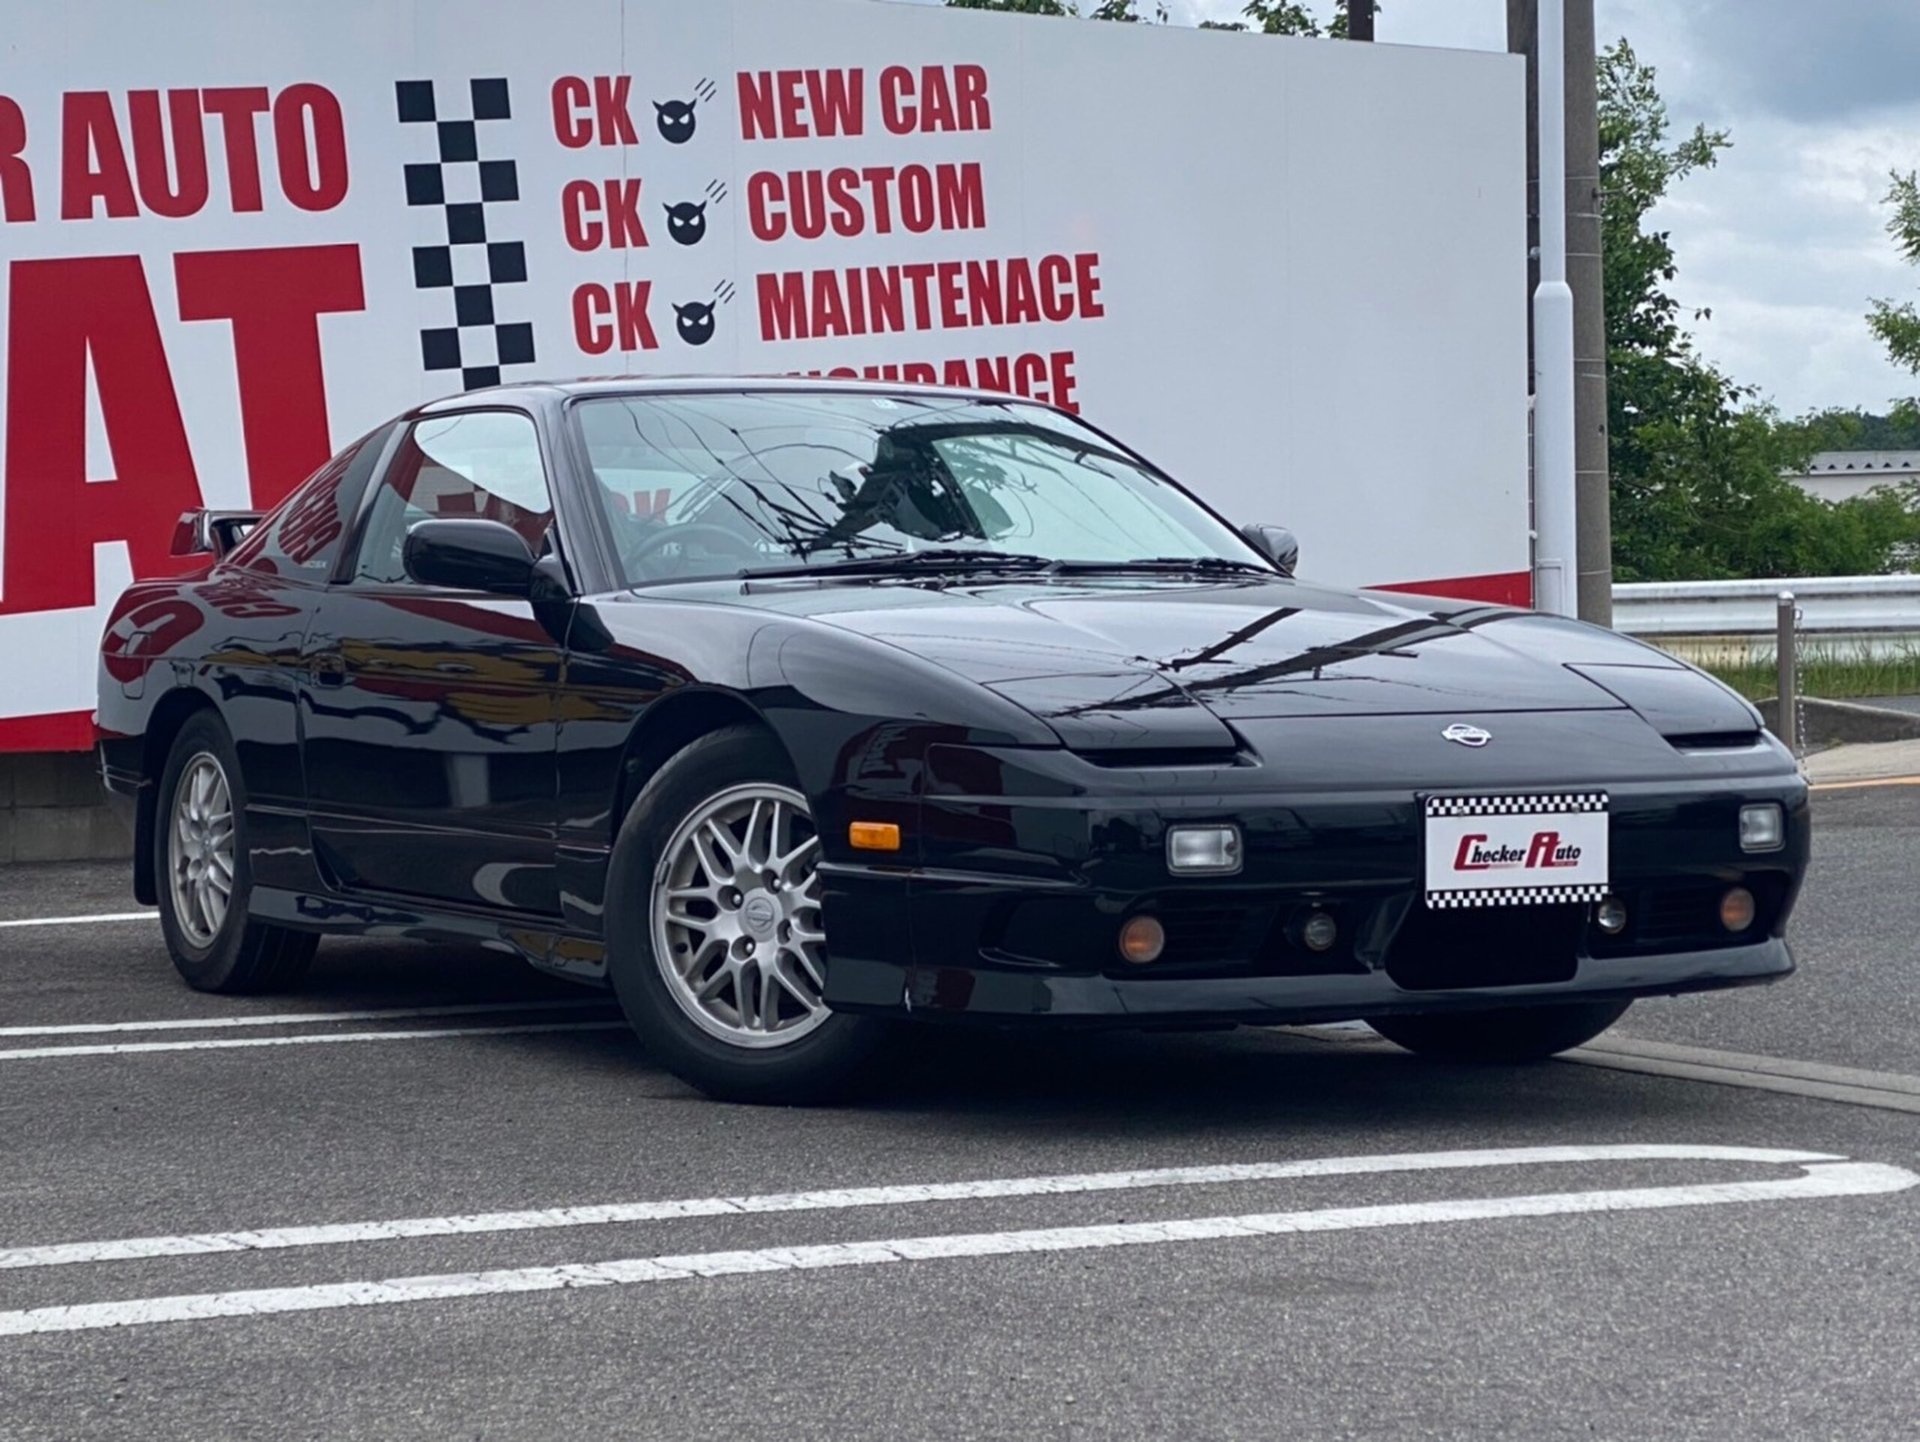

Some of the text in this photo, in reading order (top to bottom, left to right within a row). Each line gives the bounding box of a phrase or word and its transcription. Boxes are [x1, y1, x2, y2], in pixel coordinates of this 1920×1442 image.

[550, 65, 991, 148] CK NEW CAR
[60, 83, 349, 220] AUTO
[561, 162, 986, 251] CK CUSTOM
[572, 252, 1104, 355] CK MAINTENACE
[1454, 831, 1582, 871] Checker Auto
